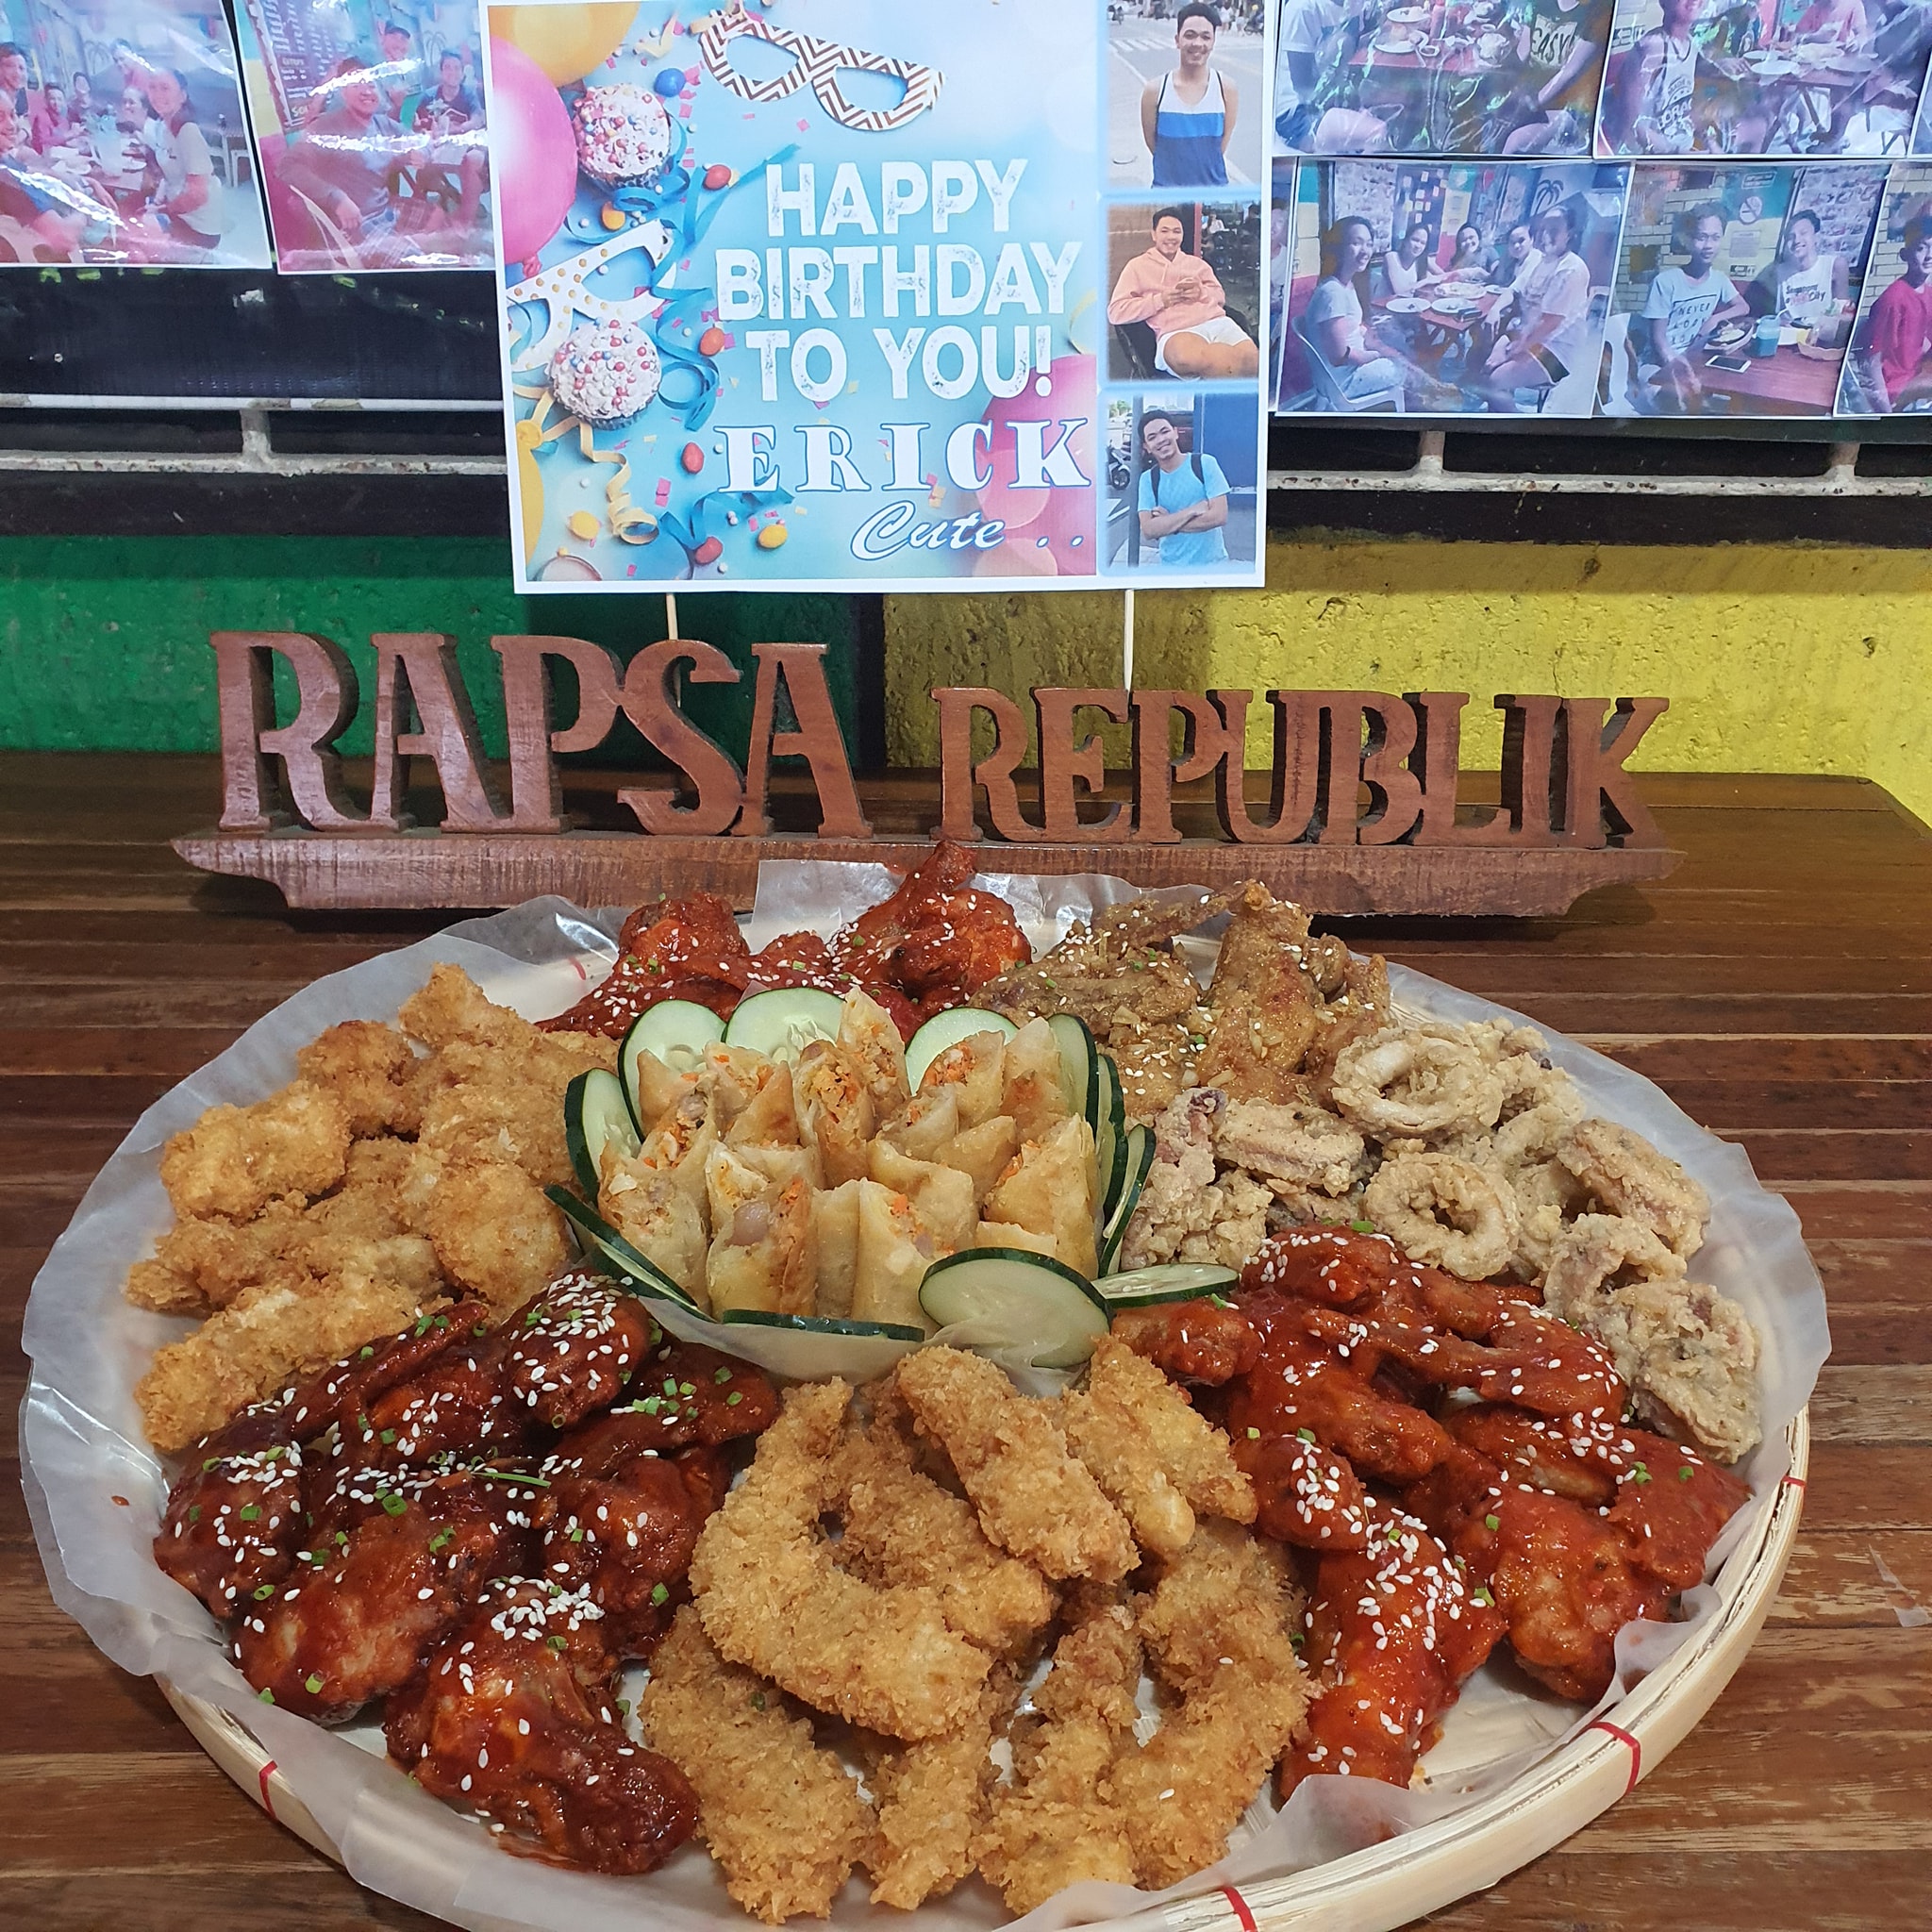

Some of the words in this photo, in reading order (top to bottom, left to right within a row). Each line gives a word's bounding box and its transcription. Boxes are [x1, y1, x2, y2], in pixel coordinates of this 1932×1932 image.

[766, 158, 1029, 238] HAPPY
[715, 242, 1083, 322] BIRTHDAY
[745, 328, 848, 403] TO
[873, 325, 1054, 400] YOU!
[713, 417, 1092, 493] ERICK
[209, 631, 874, 839] RAPSA
[929, 687, 1671, 849] REPUBLIK
